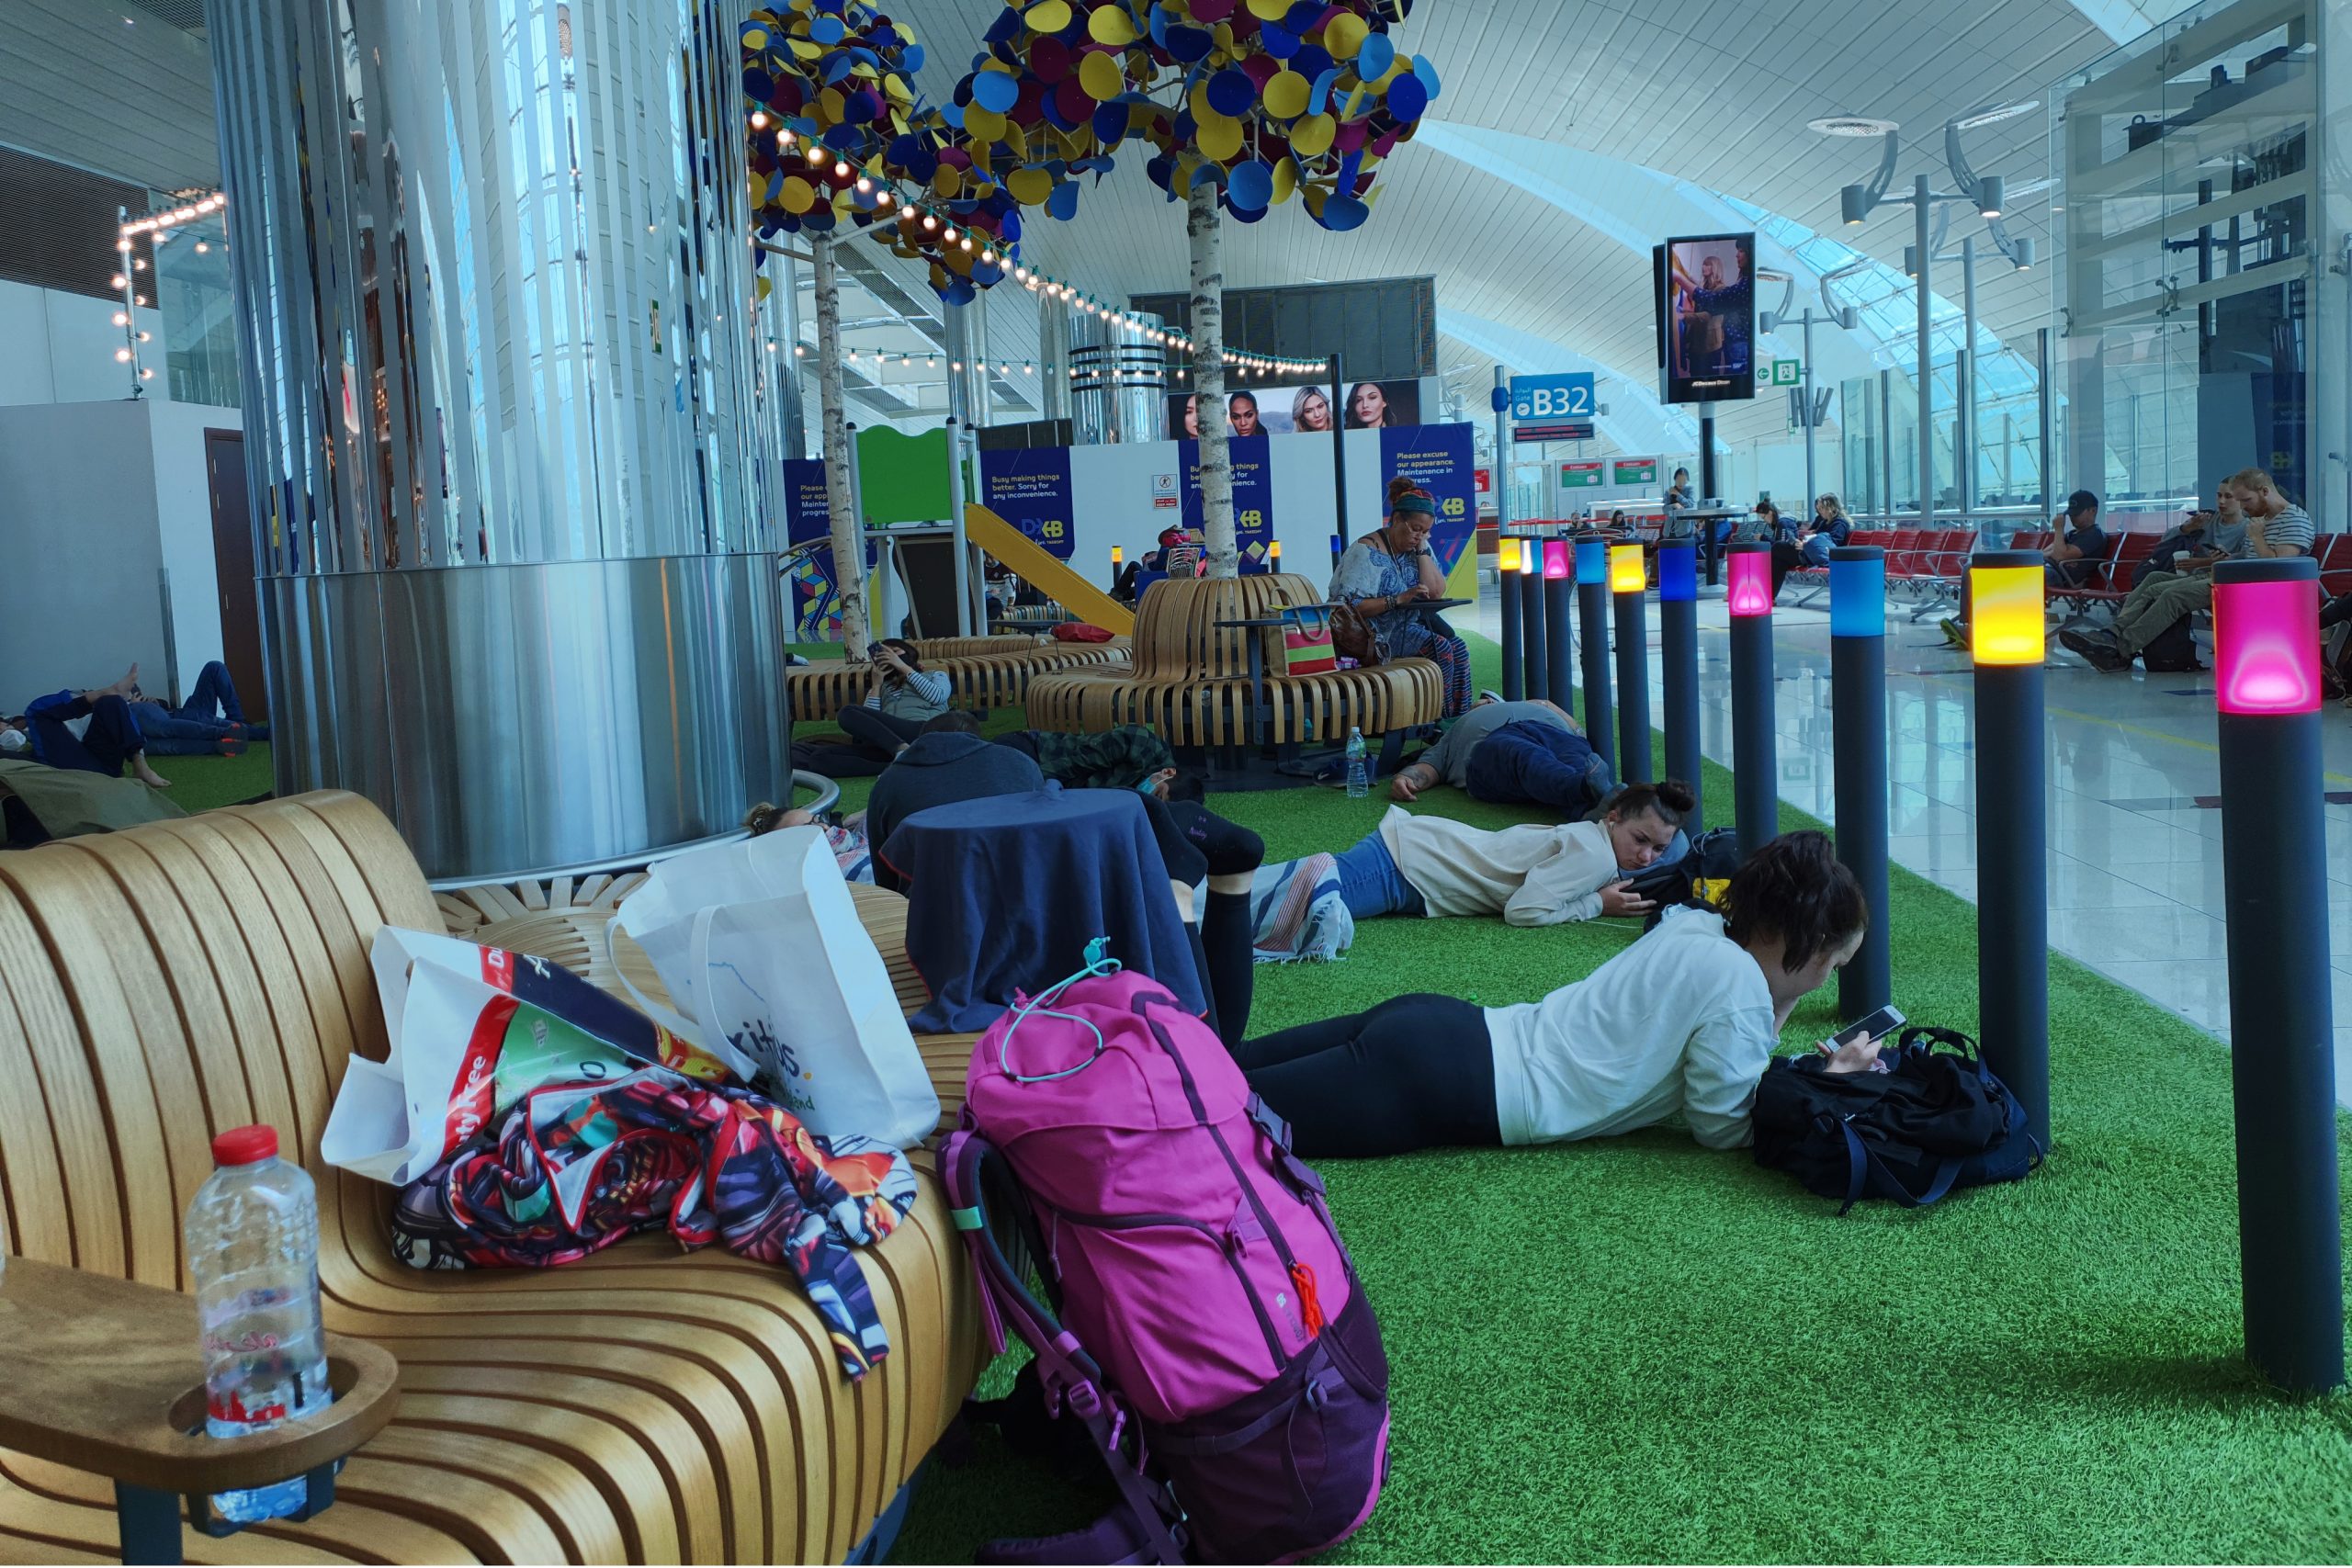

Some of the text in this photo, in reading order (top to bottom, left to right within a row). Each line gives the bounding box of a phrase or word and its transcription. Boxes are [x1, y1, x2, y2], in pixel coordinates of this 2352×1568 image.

[1532, 386, 1589, 416] B32
[1410, 459, 1455, 468] appearance.
[1397, 468, 1445, 476] Maintenance
[991, 476, 1010, 484] Busy
[1011, 474, 1036, 482] making
[1017, 482, 1037, 491] Sorry
[1007, 491, 1058, 499] inconvenience.
